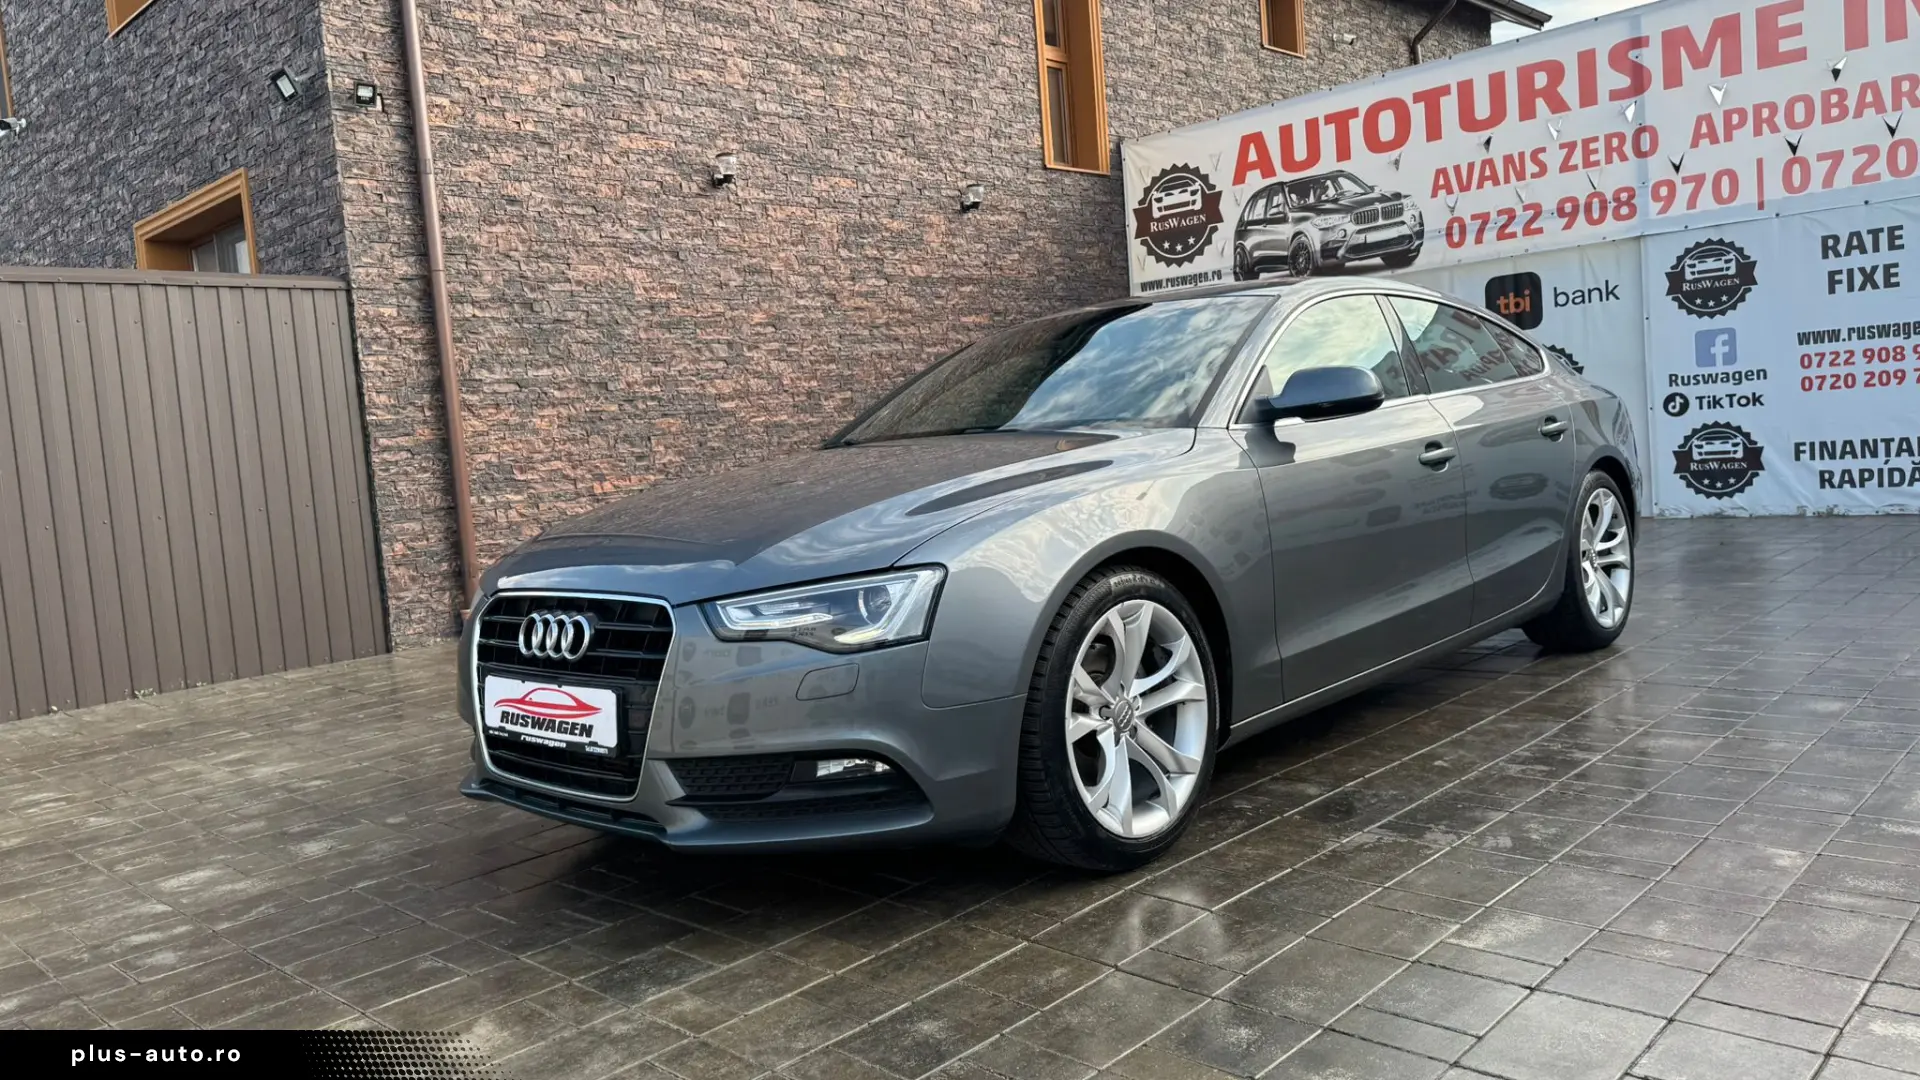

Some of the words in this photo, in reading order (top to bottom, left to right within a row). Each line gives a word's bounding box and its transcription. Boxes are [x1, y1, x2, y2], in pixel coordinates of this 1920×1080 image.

[1232, 0, 1807, 186] AUTOTURISME
[1431, 147, 1548, 199] AVANS
[1558, 125, 1659, 174] ZERO
[1690, 73, 1920, 149] APROBAR
[1445, 202, 1544, 249] 0722
[1556, 186, 1637, 231] 908
[1650, 169, 1739, 215] 970
[1782, 137, 1919, 195] 0720
[1821, 224, 1905, 260] RATE
[1140, 269, 1222, 292] www.ruswagen.ro
[1827, 262, 1900, 295] FIXE
[1497, 289, 1530, 315] tbi
[1553, 279, 1620, 308] bank
[1800, 350, 1856, 369] 0722
[1862, 345, 1906, 364] 908
[1668, 368, 1768, 388] Ruswagen
[1800, 372, 1857, 392] 0720
[1863, 368, 1906, 388] 209
[1695, 392, 1764, 410] TikTok
[1794, 436, 1920, 465] FINANȚA
[500, 711, 594, 738] RUSWAGEN
[521, 734, 566, 748] ruswagen
